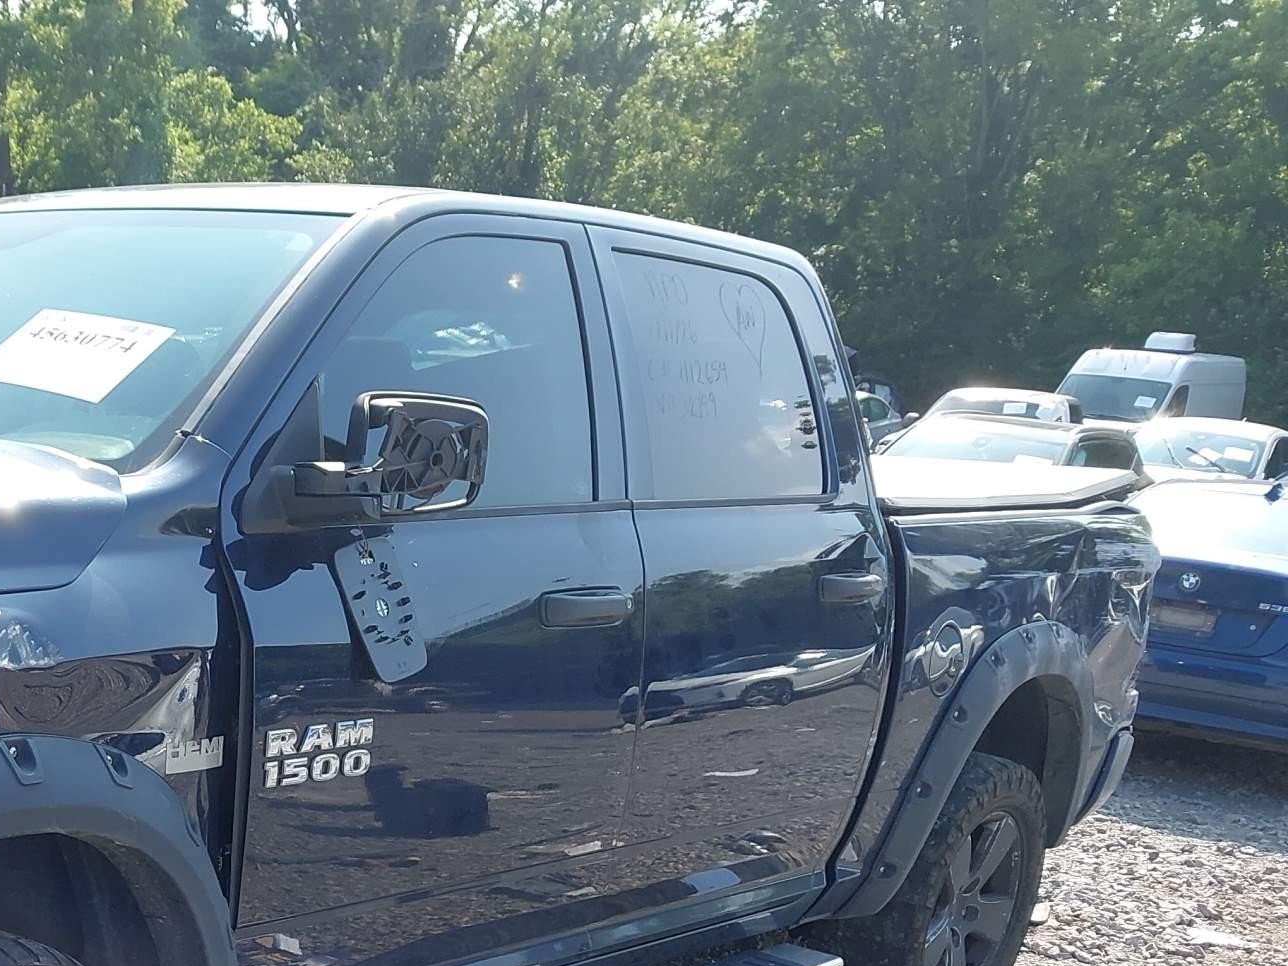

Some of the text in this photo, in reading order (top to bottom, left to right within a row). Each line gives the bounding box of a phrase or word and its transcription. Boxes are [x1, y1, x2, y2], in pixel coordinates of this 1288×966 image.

[29, 326, 139, 353] 45630774
[165, 735, 225, 762] HEMI
[265, 717, 374, 758] RAM
[263, 748, 372, 789] 1500
